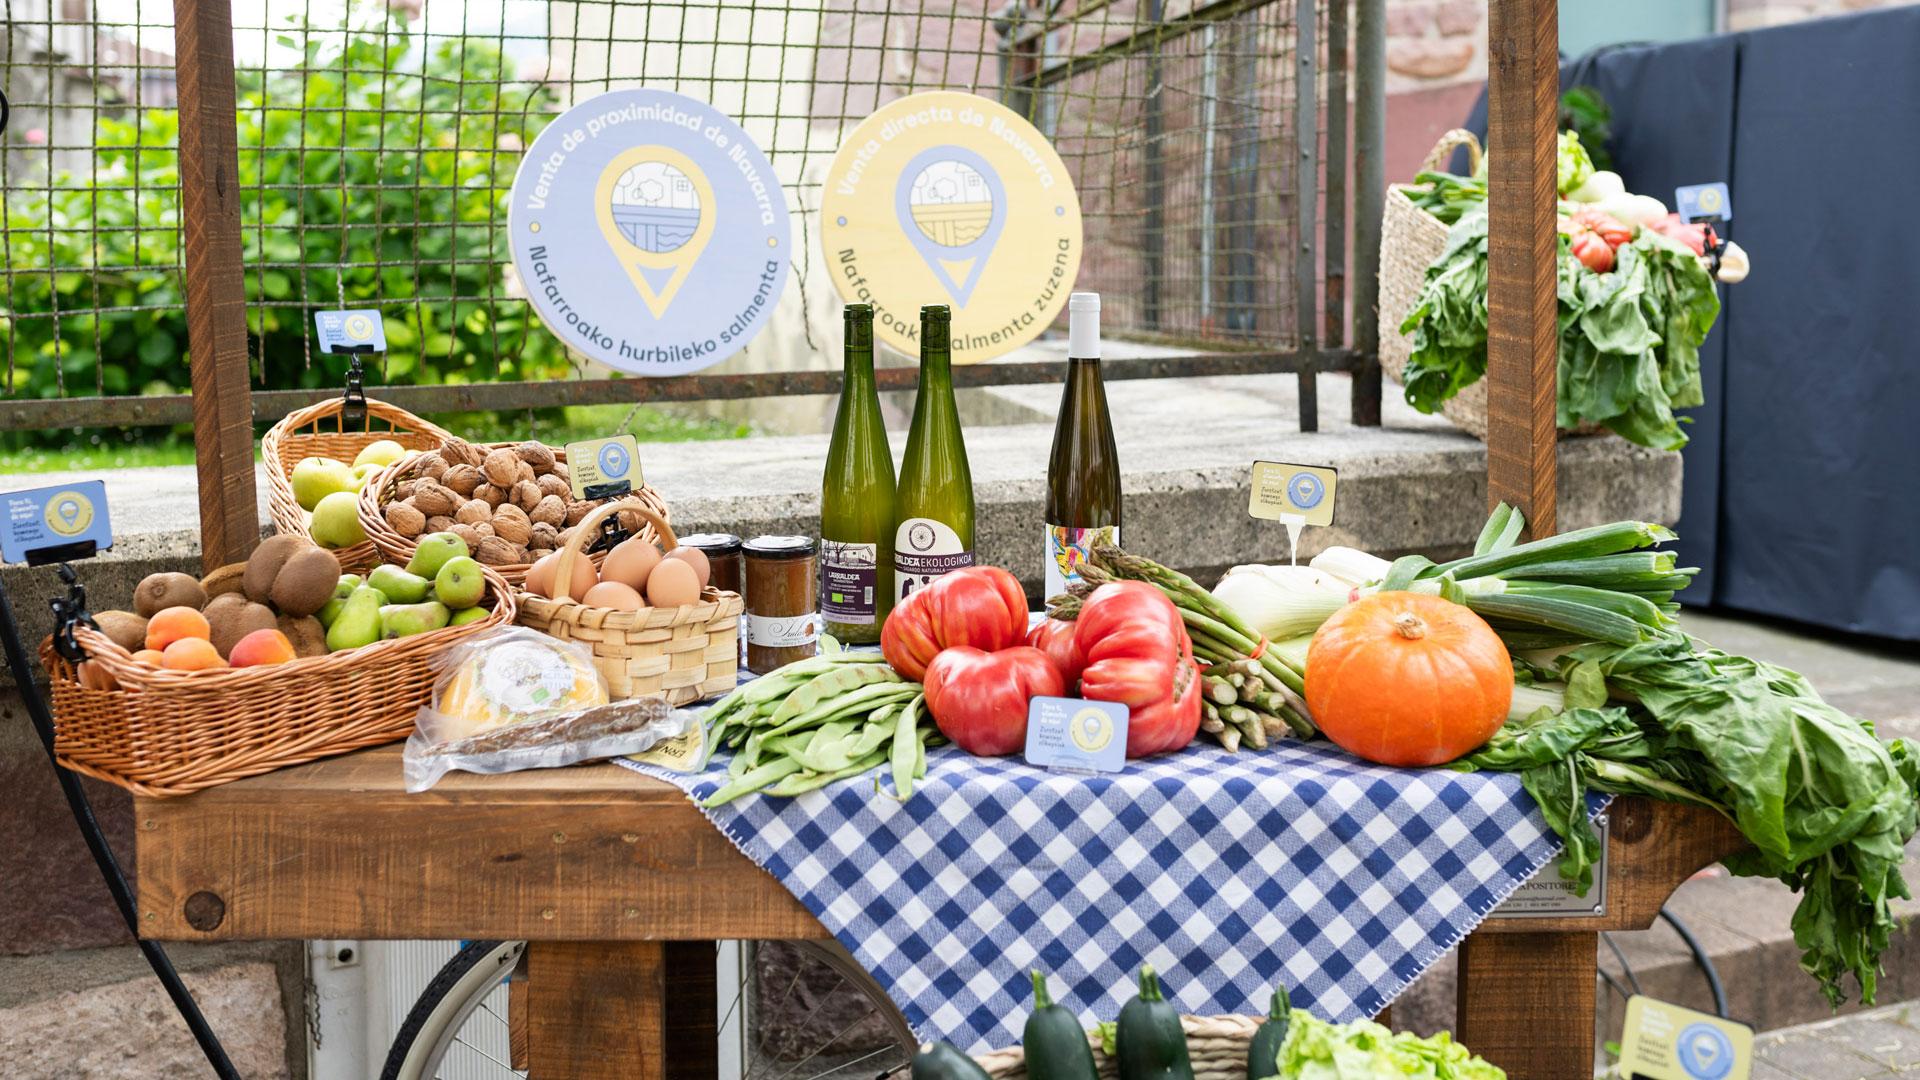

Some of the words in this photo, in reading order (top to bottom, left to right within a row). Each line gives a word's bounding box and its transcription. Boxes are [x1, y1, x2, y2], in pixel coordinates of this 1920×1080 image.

[526, 152, 566, 210] Venta
[562, 127, 586, 153] de
[586, 103, 703, 138] proximidad
[704, 125, 729, 149] de
[728, 143, 776, 227] Navarra
[837, 137, 881, 197] Venta
[880, 106, 953, 142] directa
[958, 107, 985, 126] de
[988, 116, 1055, 190] Navarra
[529, 245, 614, 351] Nafarroako
[619, 340, 717, 364] hurbileko
[721, 260, 779, 344] salmenta
[838, 248, 919, 342] Nafarroak
[952, 312, 1035, 351] almenta
[1036, 237, 1070, 312] zuzena
[920, 555, 973, 567] EKOLOGIKOA
[1517, 881, 1576, 890] XPOSITORE
